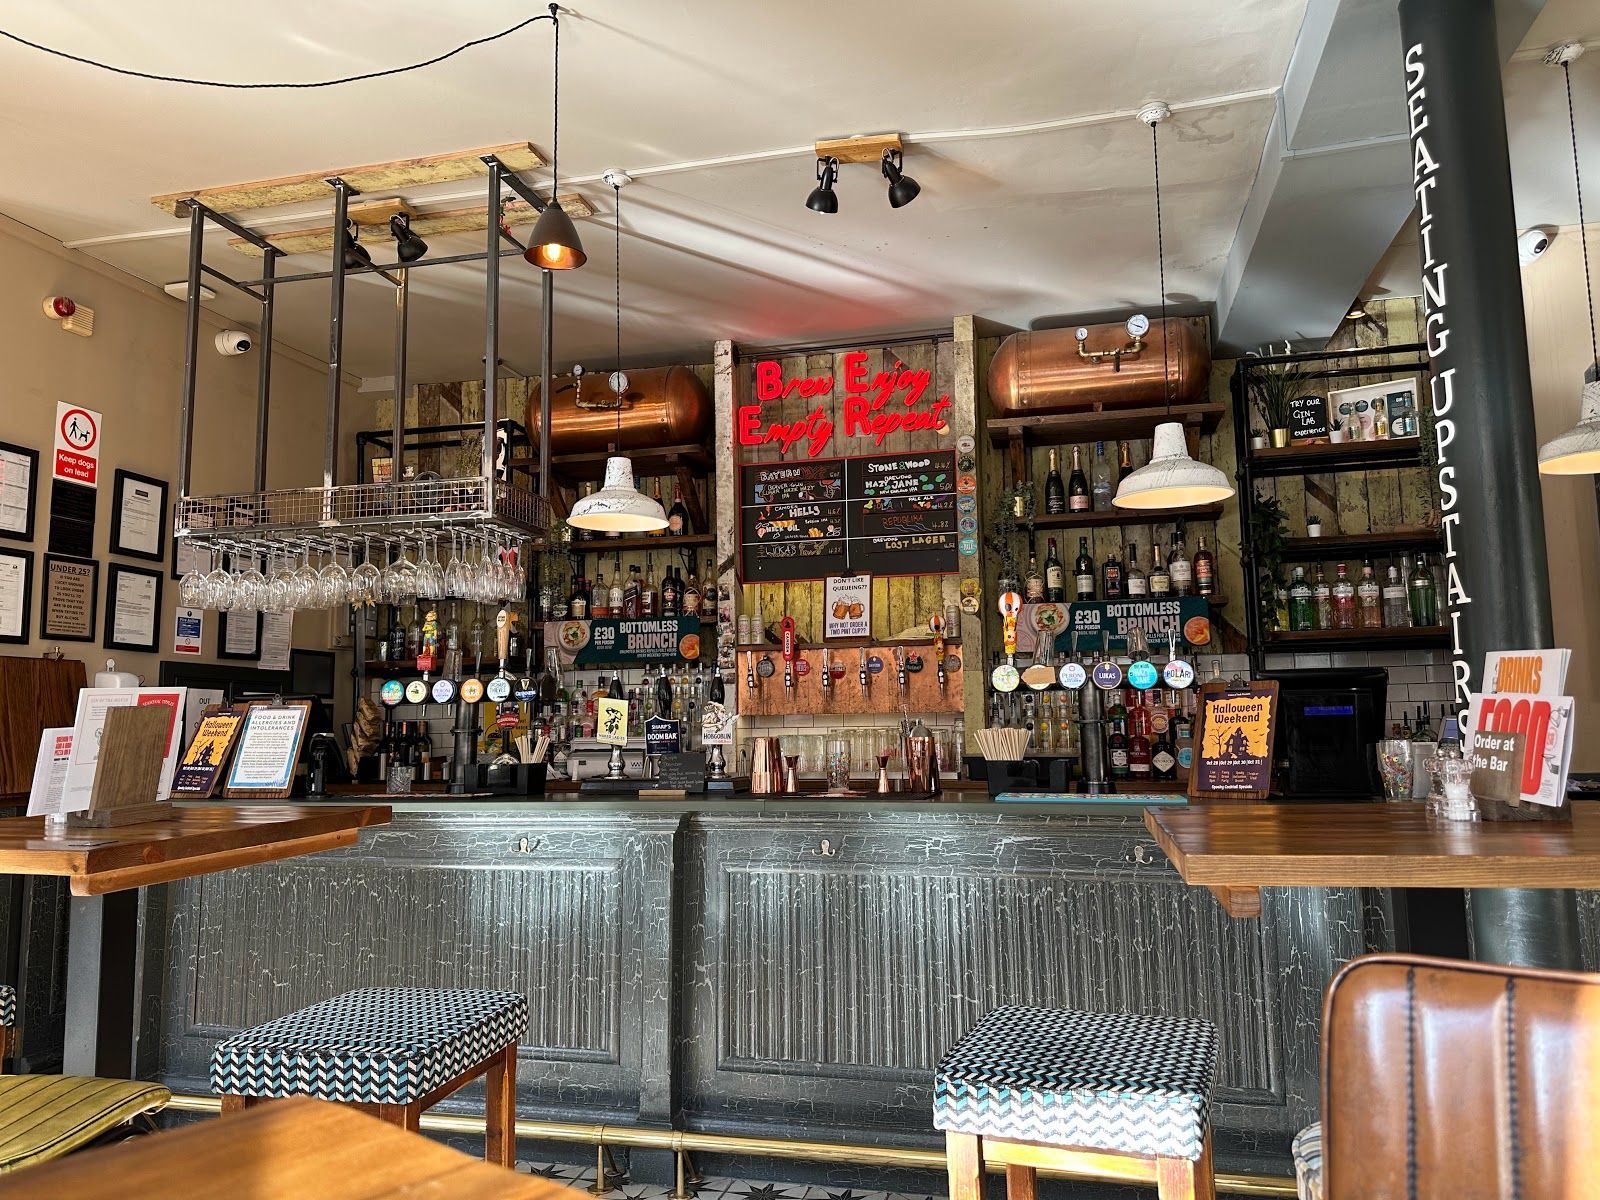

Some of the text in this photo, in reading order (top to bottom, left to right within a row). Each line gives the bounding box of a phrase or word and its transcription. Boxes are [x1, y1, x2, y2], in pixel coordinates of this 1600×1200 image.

[1405, 43, 1451, 358] SEATING
[756, 352, 931, 410] Brew Enjoy
[1290, 400, 1305, 408] TRY
[739, 392, 952, 457] Empty Repeat
[1294, 426, 1326, 436] experience
[58, 454, 94, 470] Keep dogs
[868, 462, 898, 473] STONE
[905, 459, 930, 469] WOOD
[75, 468, 88, 478] lead
[865, 480, 888, 488] HAZY
[892, 479, 919, 489] JANE
[789, 506, 820, 518] HELLS
[886, 541, 909, 549] LOST
[912, 535, 946, 544] LAGER
[50, 564, 90, 576] UNDER 25?
[1107, 601, 1180, 617] BOTTOMLESS
[1075, 609, 1100, 624] £30
[620, 620, 678, 633] BOTTOMLESS
[1117, 615, 1180, 634] BRUNCH
[594, 627, 615, 640] £30
[628, 633, 677, 649] BRUNCH
[1497, 656, 1542, 694] DRINKS
[1212, 703, 1263, 714] Halloween
[204, 720, 233, 729] Halloween
[1215, 712, 1260, 723] Weekend
[1474, 734, 1514, 751] Order at
[1473, 755, 1508, 772] the Bar
